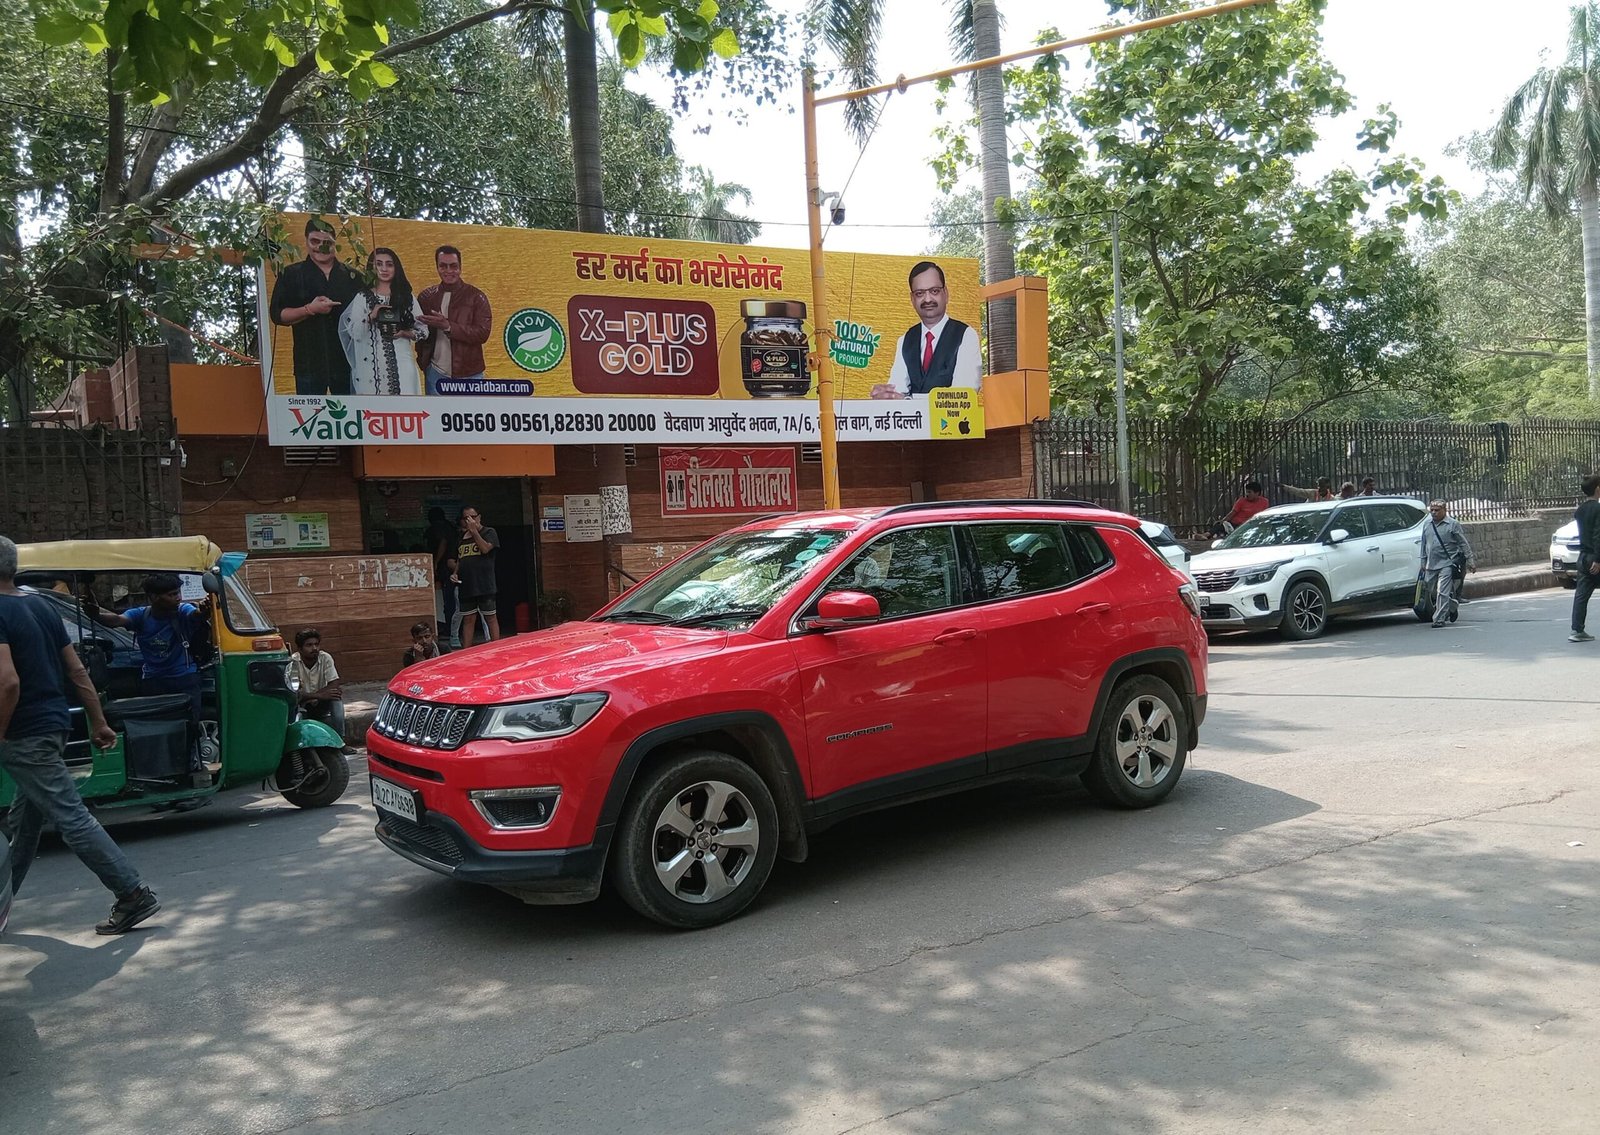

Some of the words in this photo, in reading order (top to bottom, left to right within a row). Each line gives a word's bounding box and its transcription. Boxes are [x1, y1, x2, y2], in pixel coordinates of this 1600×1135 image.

[573, 252, 607, 280] हर
[611, 248, 649, 283] मर्द
[653, 258, 683, 285] का
[689, 254, 783, 290] भरोसेमंद
[514, 316, 545, 332] NON
[578, 309, 707, 344] X-PLUS
[835, 320, 873, 342] 100%
[524, 342, 559, 366] TOXIC
[834, 340, 872, 355] NATURAL
[599, 343, 693, 376] GOLD
[838, 353, 866, 366] PRODUCT
[440, 381, 530, 394] www.vaidban.com
[936, 391, 968, 400] DOWNLOAD
[288, 398, 306, 406] Since
[306, 398, 322, 406] 1992
[960, 400, 971, 410] App
[441, 412, 496, 434] 90560
[501, 413, 604, 435] 90561,82830
[608, 413, 656, 433] 20000
[664, 411, 704, 432] वैदबाण
[708, 412, 746, 437] आयुर्वेद
[749, 416, 781, 434] भवन,
[783, 413, 815, 434] 7A/6,
[850, 416, 873, 433] बाग,
[874, 411, 891, 431] नई
[892, 411, 923, 430] दिल्ली
[686, 456, 735, 509] डीलक्स
[737, 455, 792, 507] शौचालय
[826, 723, 893, 742] COMPASS
